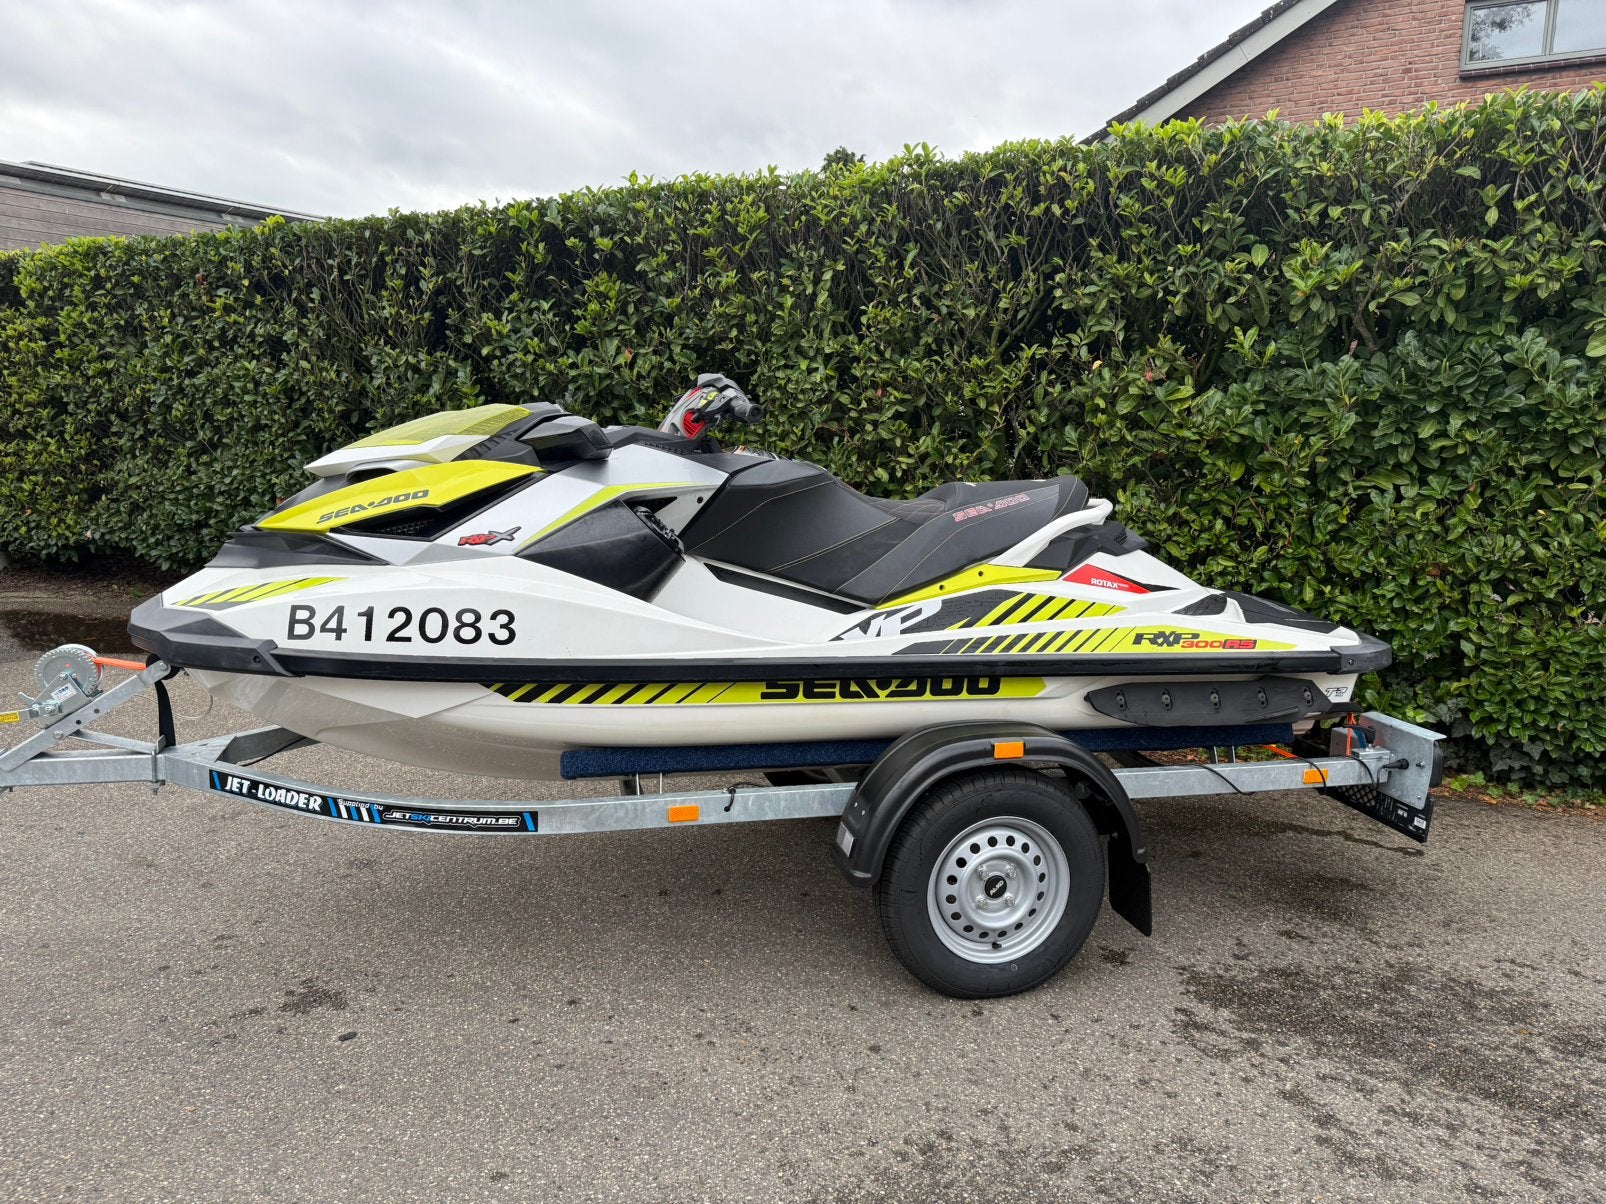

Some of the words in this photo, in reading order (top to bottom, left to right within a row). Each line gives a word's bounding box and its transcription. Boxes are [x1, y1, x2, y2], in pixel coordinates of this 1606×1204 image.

[1090, 577, 1119, 589] ROTAX
[286, 604, 517, 646] B412083
[1132, 630, 1201, 647] RXP
[1180, 639, 1224, 649] 300
[384, 809, 519, 826] JETSKICENTRUM.BE
